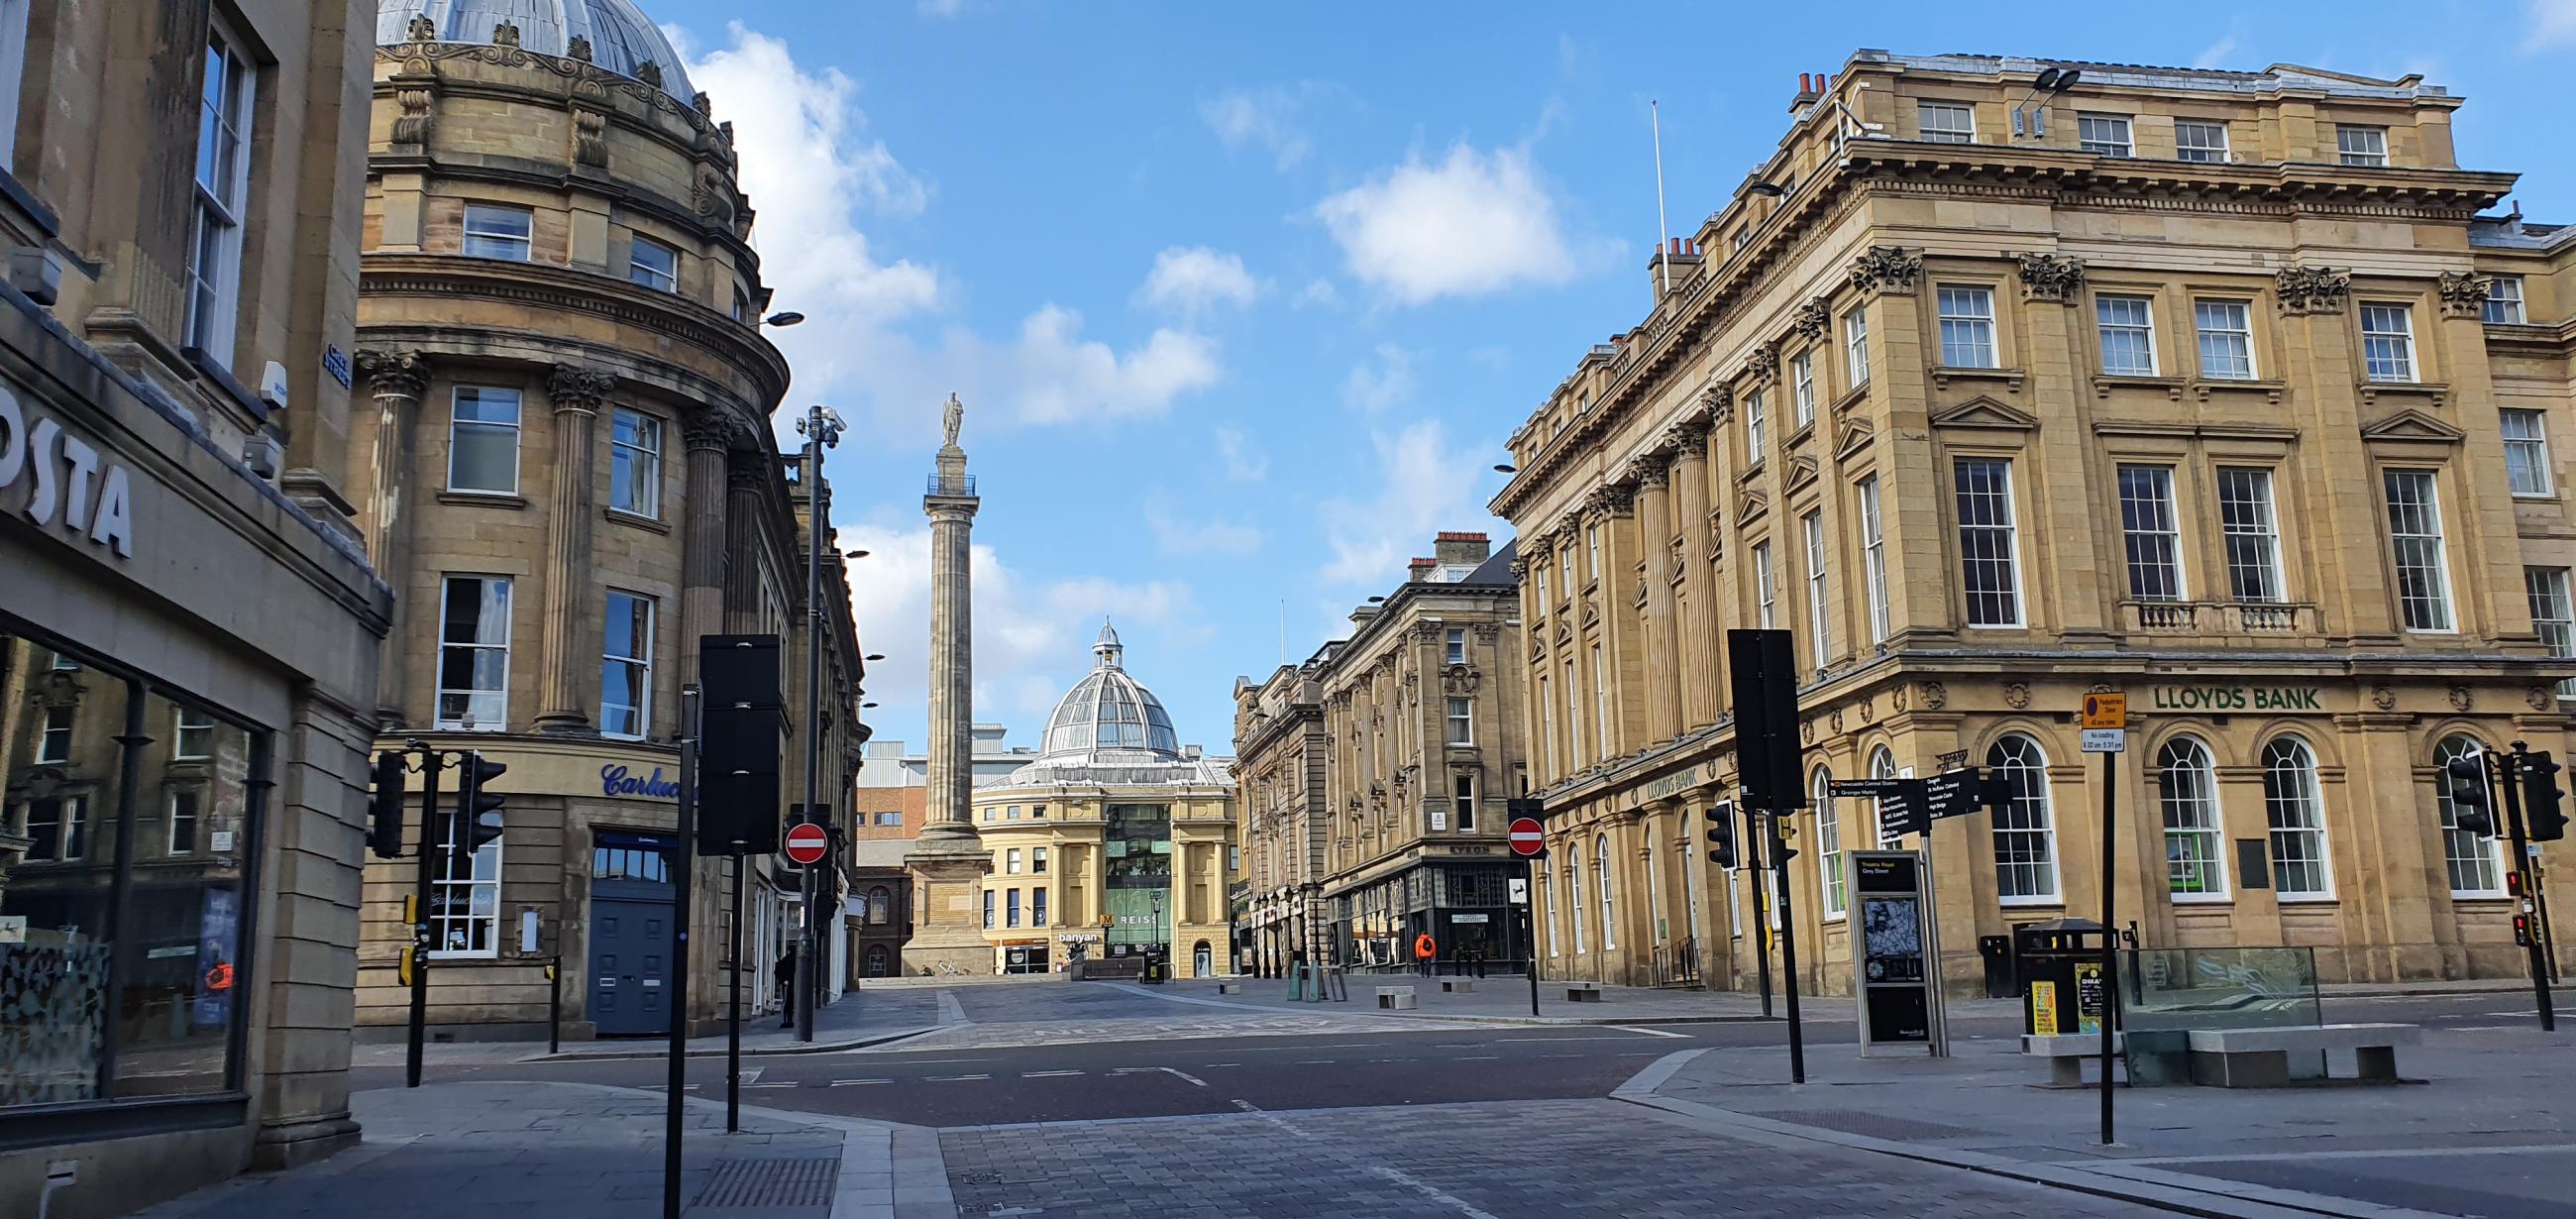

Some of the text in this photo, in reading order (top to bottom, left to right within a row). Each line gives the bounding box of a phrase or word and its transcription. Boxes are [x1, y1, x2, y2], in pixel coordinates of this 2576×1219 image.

[2154, 687, 2320, 710] LLOYDS BANK
[1647, 767, 1697, 800] LLOYDS BANK
[1121, 916, 1157, 925] REISS
[1058, 933, 1098, 943] banyan
